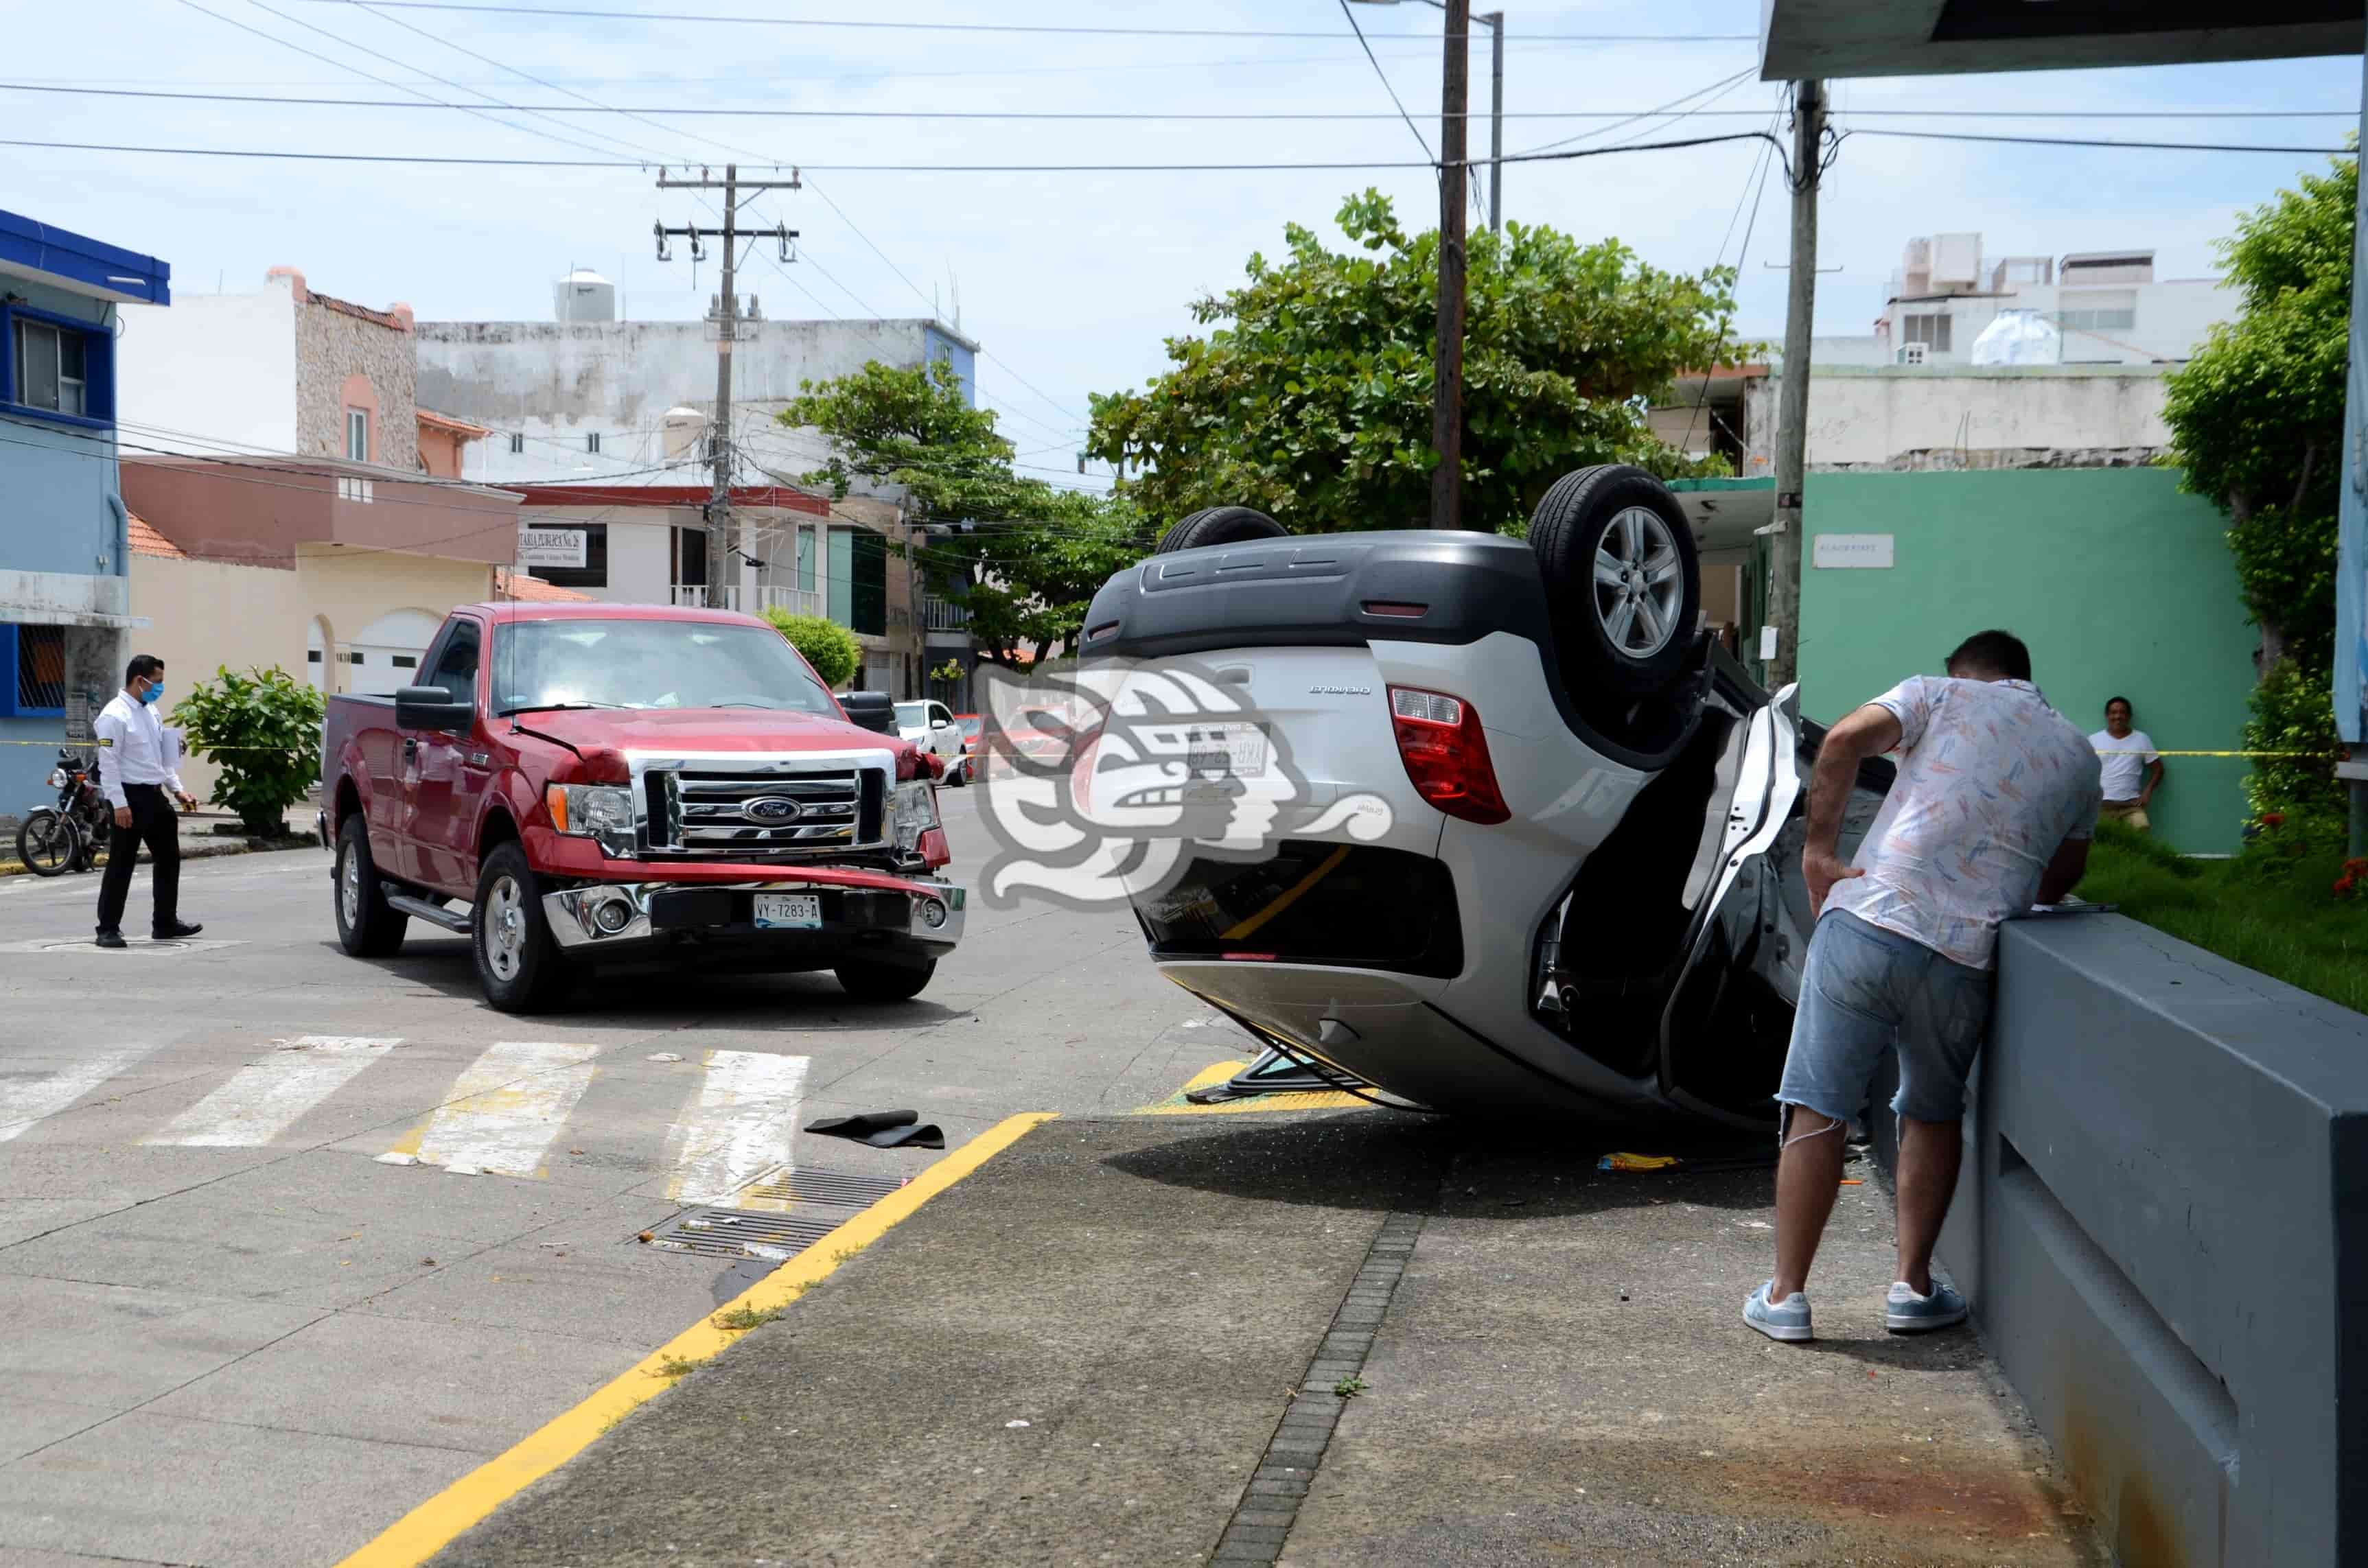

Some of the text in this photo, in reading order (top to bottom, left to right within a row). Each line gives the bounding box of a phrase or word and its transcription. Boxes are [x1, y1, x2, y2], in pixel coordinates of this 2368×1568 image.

[1308, 686, 1371, 696] CHEVROLET
[759, 801, 788, 817] Ford
[757, 904, 817, 918] VY-7283-A
